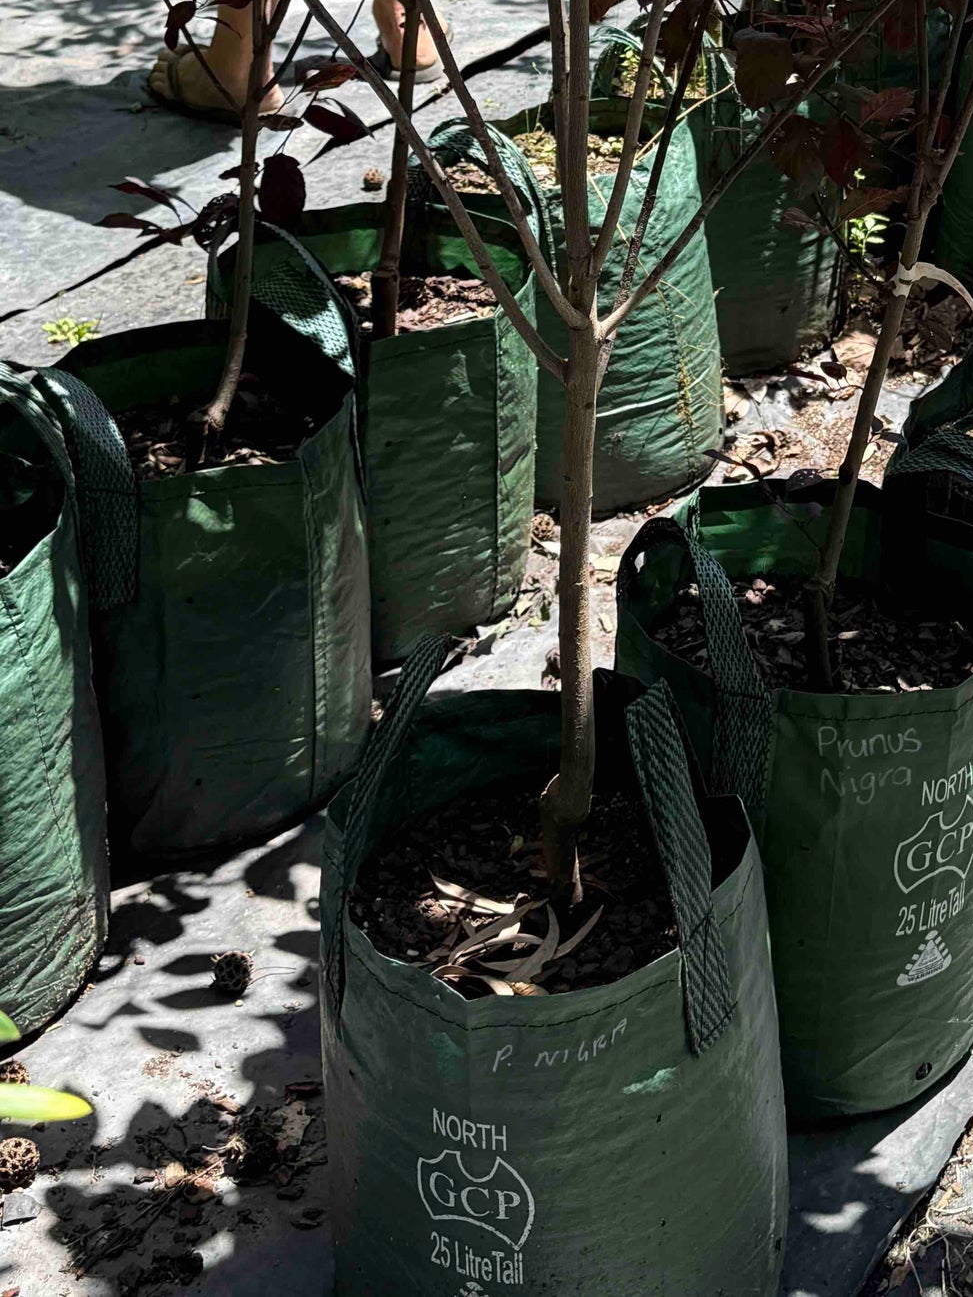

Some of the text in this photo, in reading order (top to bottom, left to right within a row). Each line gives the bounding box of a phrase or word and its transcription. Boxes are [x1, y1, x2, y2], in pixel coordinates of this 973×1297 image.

[818, 726, 922, 758] Prunus
[821, 766, 912, 805] Nigra
[921, 762, 973, 806] NORTH
[906, 822, 973, 872] GCP
[896, 905, 917, 936] 25
[432, 1107, 507, 1152] NORTH
[429, 1171, 521, 1220] GCP
[430, 1231, 451, 1268] 25
